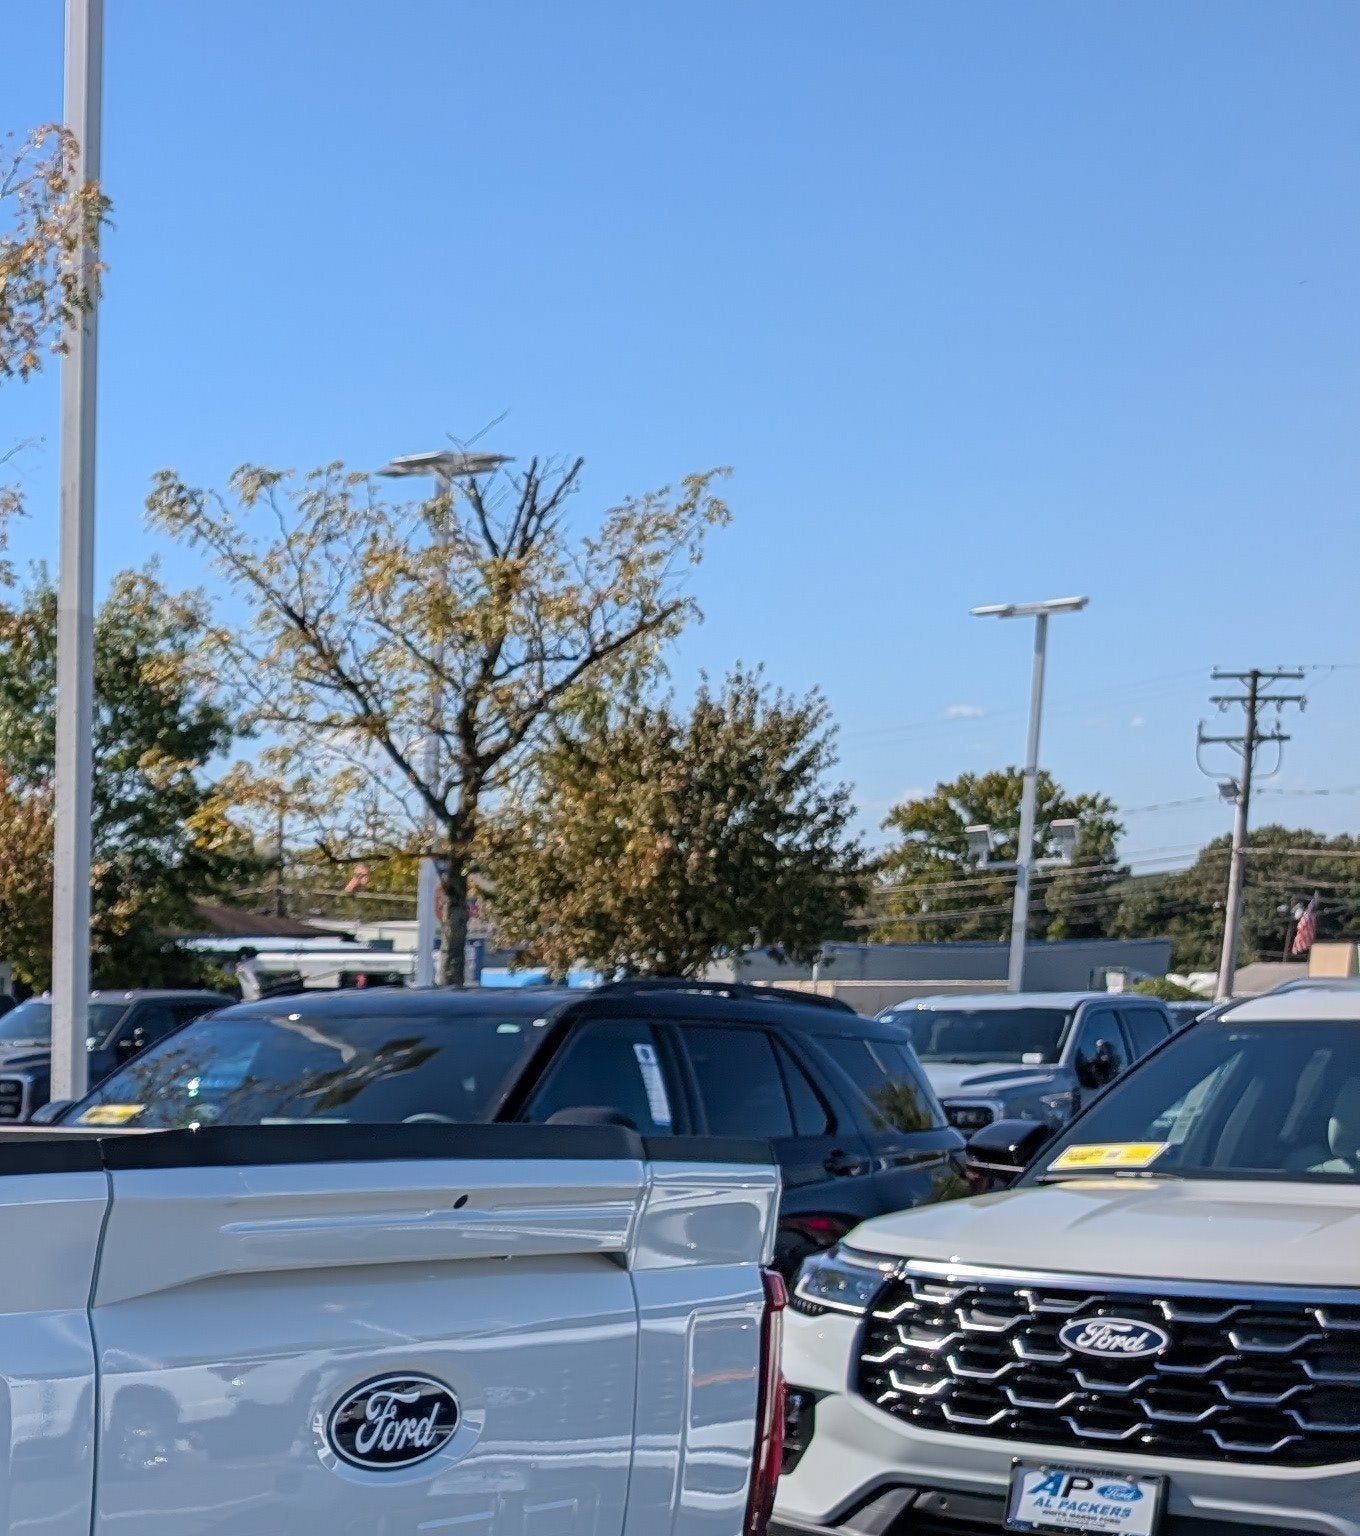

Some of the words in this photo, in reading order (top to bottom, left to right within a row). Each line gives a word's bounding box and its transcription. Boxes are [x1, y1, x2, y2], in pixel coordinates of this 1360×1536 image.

[355, 1391, 440, 1454] Ford
[1027, 1472, 1094, 1498] AP
[1033, 1497, 1051, 1508] AL
[1058, 1499, 1132, 1519] PACKERS
